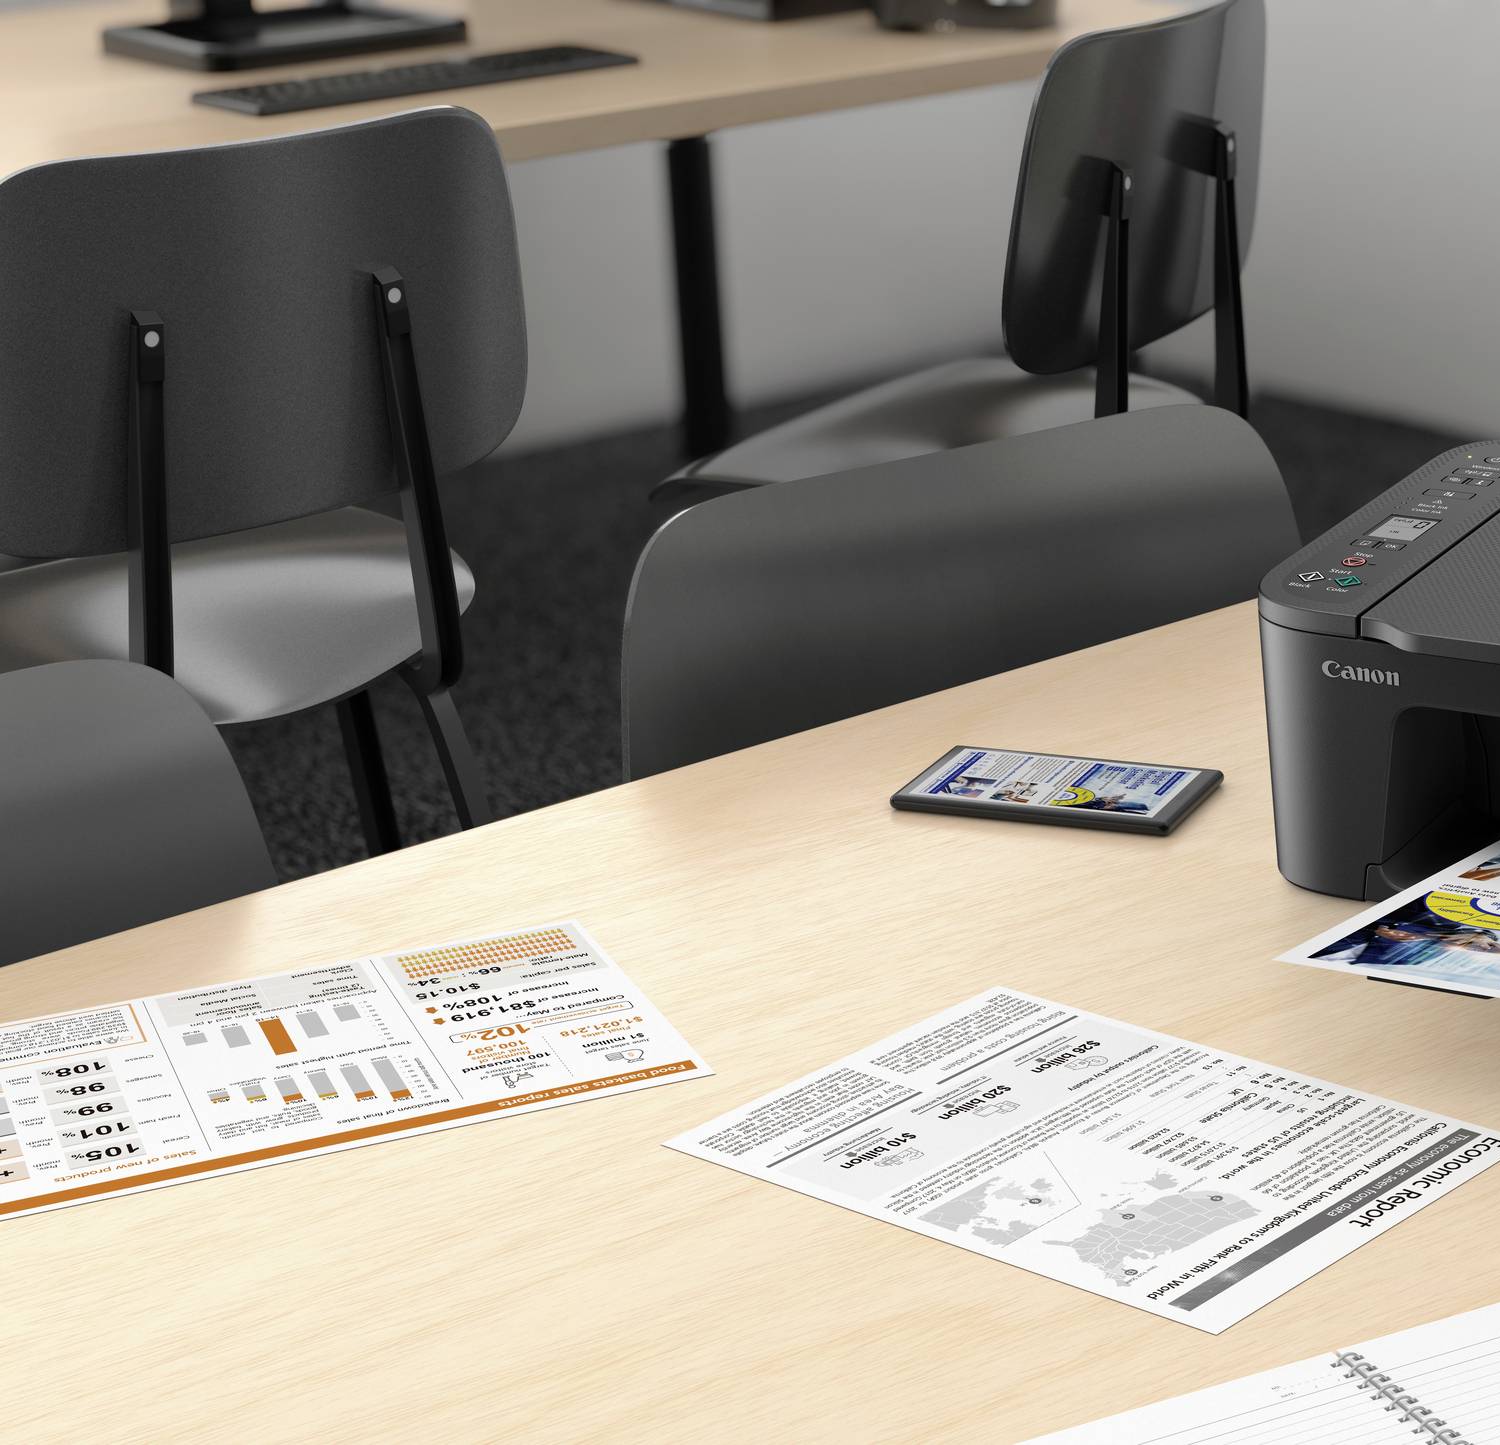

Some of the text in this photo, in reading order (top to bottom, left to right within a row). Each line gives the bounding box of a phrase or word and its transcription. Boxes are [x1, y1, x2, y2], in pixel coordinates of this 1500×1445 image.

[1354, 551, 1374, 559] Stop
[1288, 581, 1311, 589] Black
[1326, 586, 1349, 594] Color
[1321, 660, 1401, 687] Canon
[1125, 769, 1158, 790] Marketing
[408, 966, 501, 986] 66% 34%
[416, 983, 480, 1000] $10.15
[522, 981, 569, 992] Increase
[552, 987, 599, 999] Increase
[443, 995, 502, 1011] 108%
[451, 1000, 536, 1022] $81,919
[458, 1021, 530, 1040] 102%
[560, 1016, 643, 1037] $1,021,218
[358, 1044, 387, 1054] period
[467, 1040, 527, 1056] 100,597
[582, 1036, 626, 1048] million
[302, 1055, 334, 1065] highest
[1031, 1040, 1100, 1073] $26 billion
[41, 1062, 106, 1077] 108%
[462, 1057, 525, 1074] thousand
[56, 1082, 105, 1096] 98%
[498, 1064, 686, 1107] Food baskets sales reports
[882, 1084, 904, 1094] Bay
[397, 1098, 450, 1112] Breakdown
[858, 1094, 883, 1106] Area
[938, 1085, 1011, 1120] $20 billion
[1220, 1093, 1258, 1112] California
[1315, 1095, 1355, 1116] including
[63, 1102, 113, 1116] 99%
[363, 1112, 383, 1120] final
[1199, 1111, 1223, 1123] State
[1313, 1097, 1366, 1127] Largest-scale
[337, 1116, 360, 1124] sales
[803, 1112, 846, 1133] dilemma
[1289, 1115, 1318, 1130] results
[62, 1122, 130, 1139] 101%
[1271, 1127, 1314, 1151] economies
[71, 1143, 139, 1162] 105%
[163, 1150, 197, 1160] Sales
[840, 1133, 916, 1169] $10 billion
[1241, 1143, 1268, 1158] states
[116, 1161, 143, 1170] new
[1246, 1156, 1264, 1165] the
[54, 1166, 111, 1182] products
[1218, 1164, 1248, 1180] world,
[1327, 1134, 1470, 1217] The economy as seen from data
[1146, 1122, 1447, 1300] California Economy Exceeds United Kingdom's to Rank Fifth in World
[1338, 1188, 1423, 1228] Report
